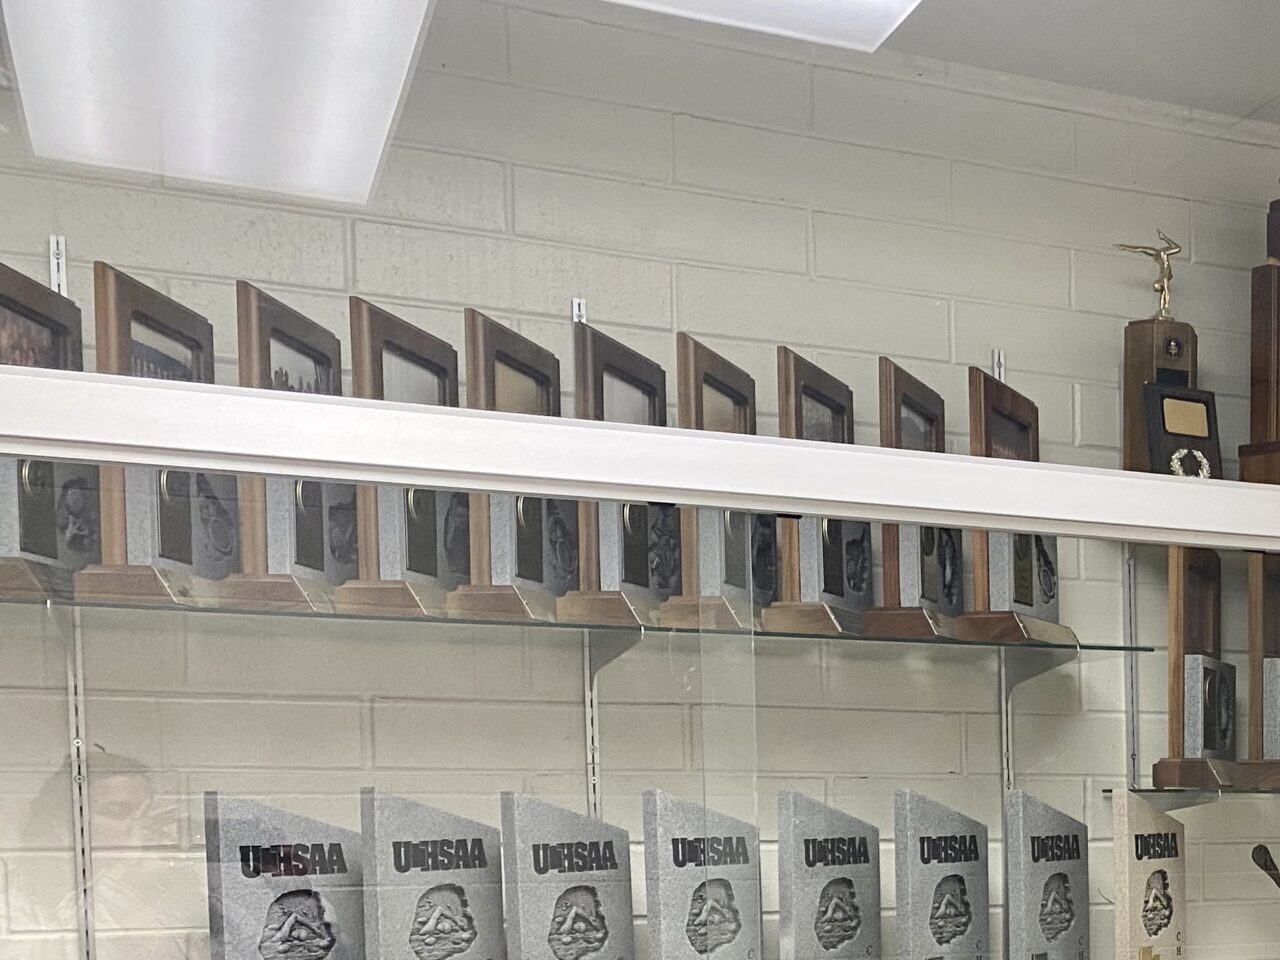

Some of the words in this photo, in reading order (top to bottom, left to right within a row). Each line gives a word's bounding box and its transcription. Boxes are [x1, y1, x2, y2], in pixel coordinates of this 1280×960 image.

[239, 843, 348, 878] UHSAA
[392, 838, 488, 873] UHSAA
[532, 840, 618, 874] UHSAA
[671, 836, 749, 867] UHSAA
[803, 836, 870, 867] UHSAA
[919, 835, 979, 864] UHSAA
[1030, 834, 1081, 862] UHSAA
[1134, 833, 1179, 860] UHSAA
